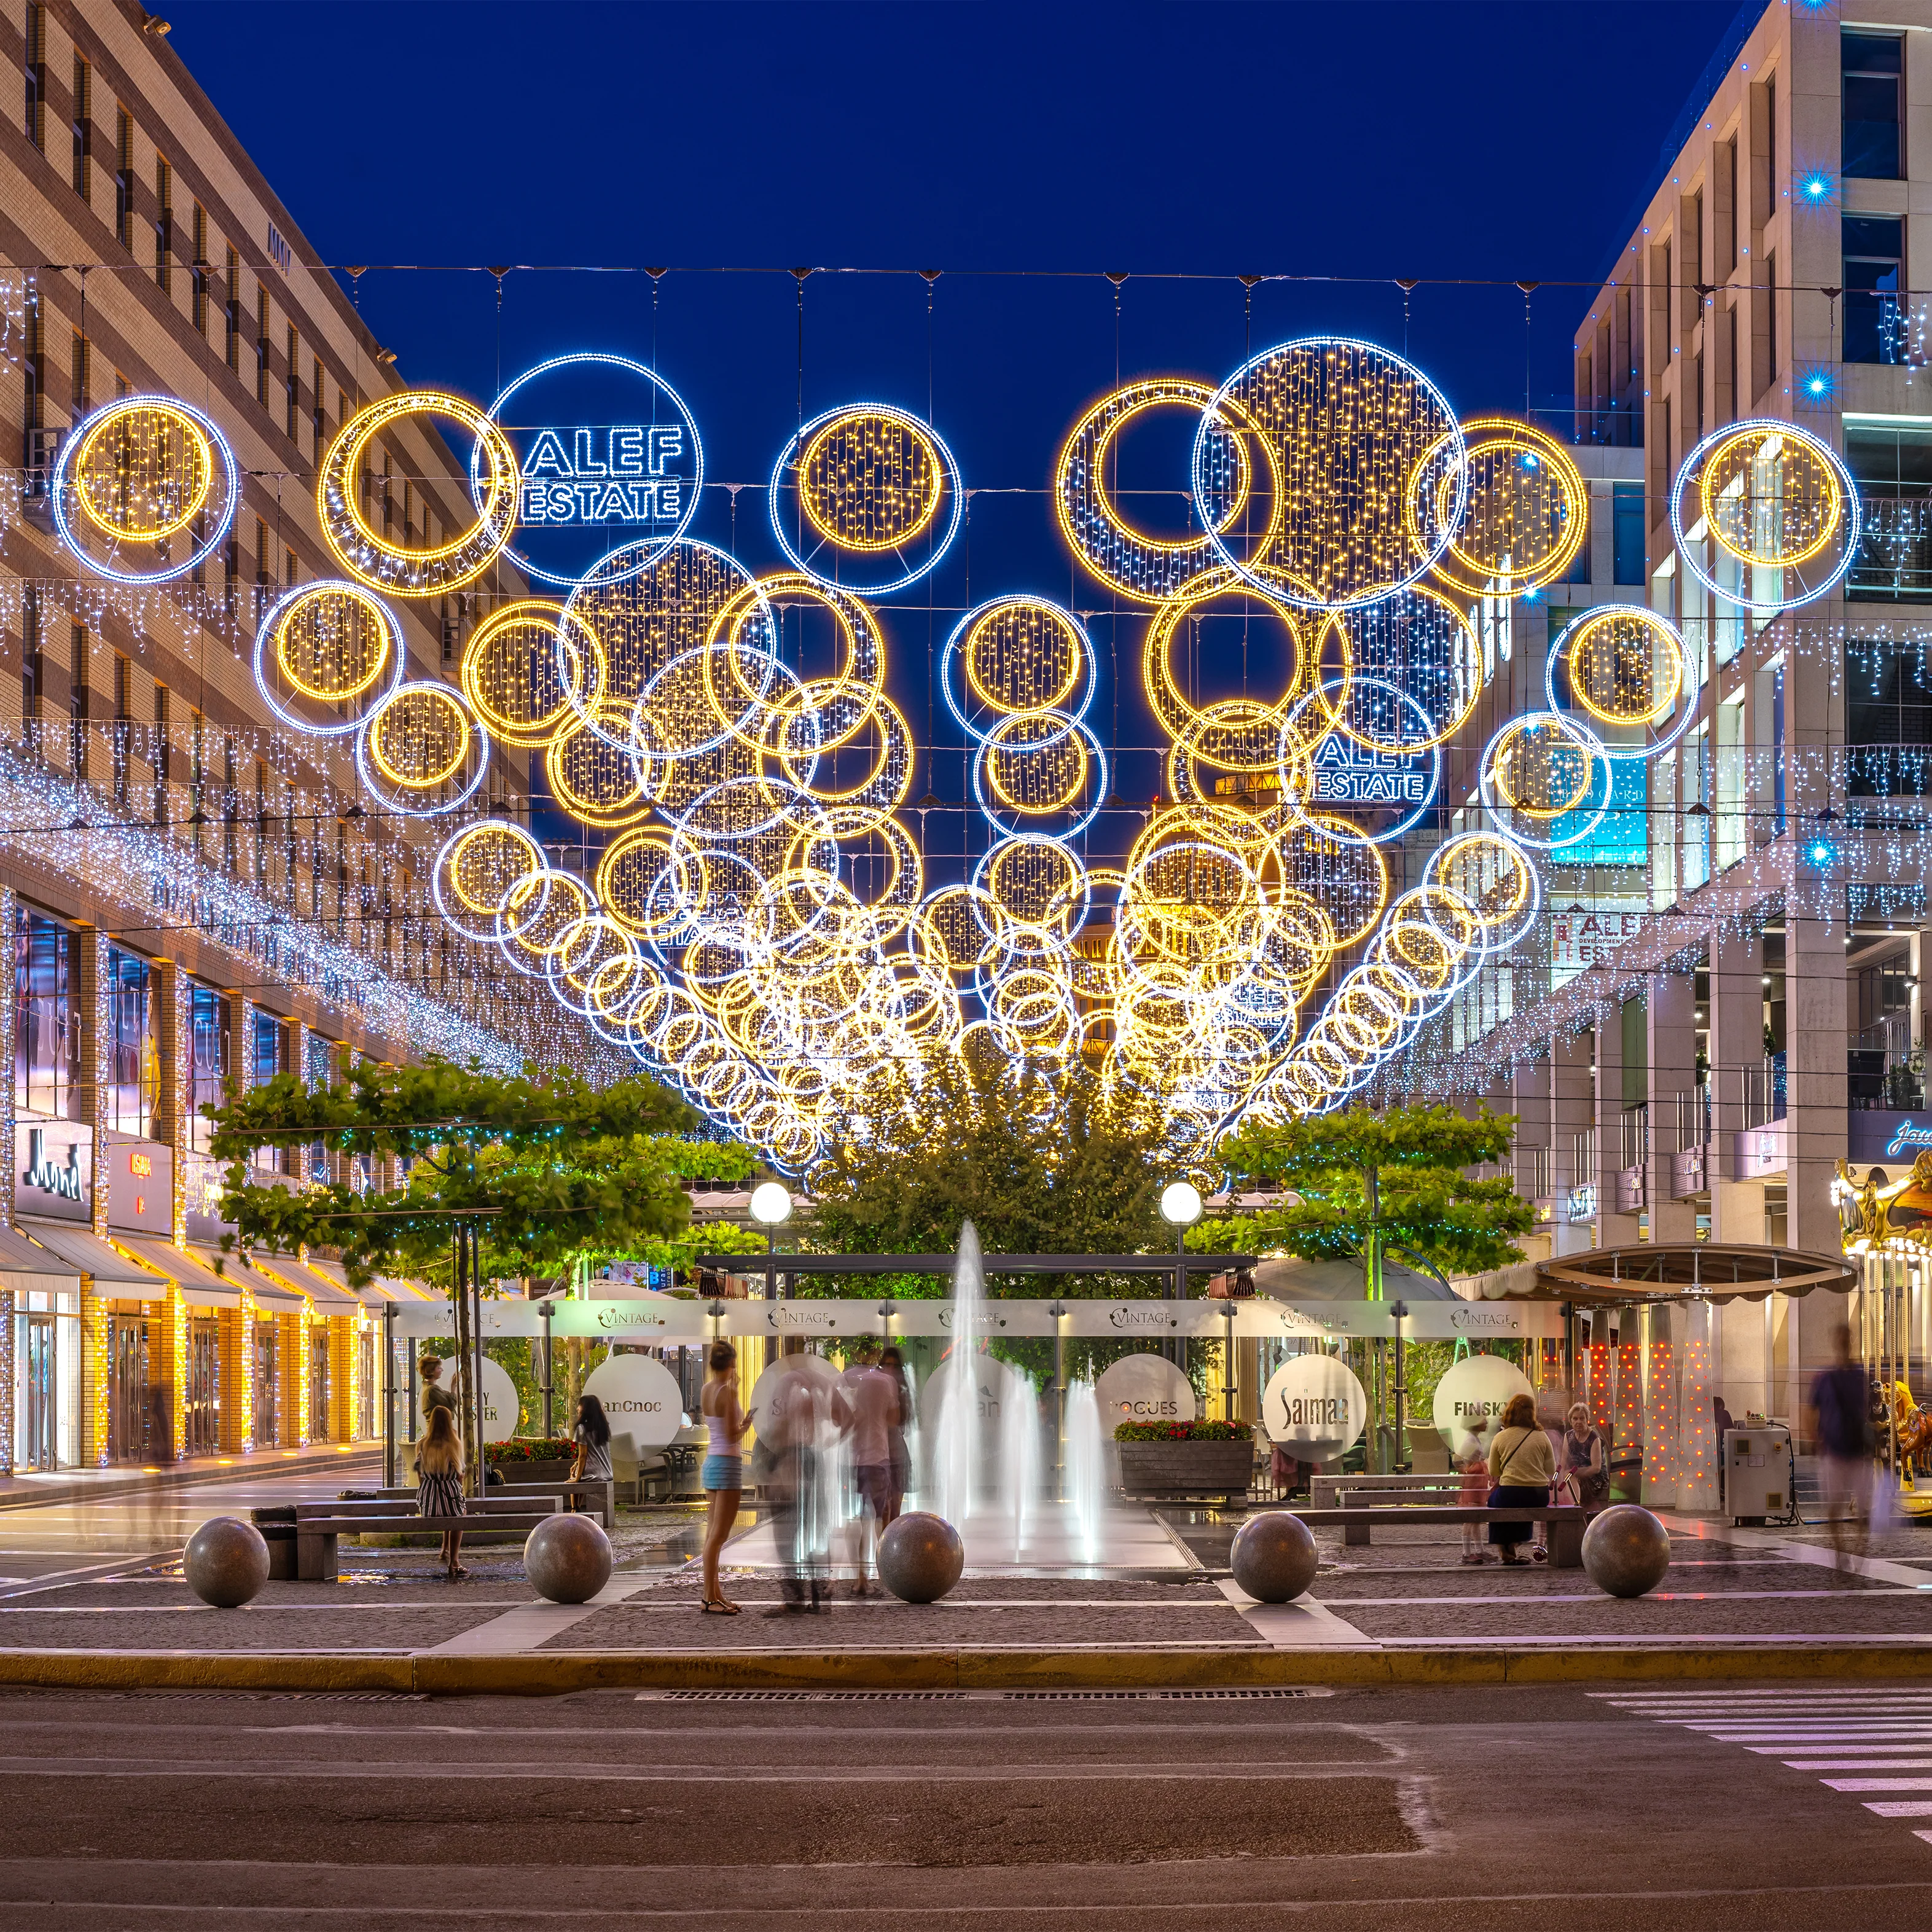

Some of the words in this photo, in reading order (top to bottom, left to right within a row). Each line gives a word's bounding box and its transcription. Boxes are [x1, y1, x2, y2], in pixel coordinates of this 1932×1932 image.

[522, 428, 682, 477] ALEF
[520, 483, 680, 521] ESTATE
[1313, 733, 1425, 768] ALEF
[1312, 772, 1424, 800] ESTATE
[605, 1313, 658, 1323] VINTAGE
[775, 1313, 829, 1323] VINTAGE
[1117, 1313, 1170, 1323] VINTAGE
[1288, 1313, 1341, 1324] VINTAGE
[1458, 1315, 1511, 1324] VINTAGE
[1281, 1388, 1348, 1429] Saimaa
